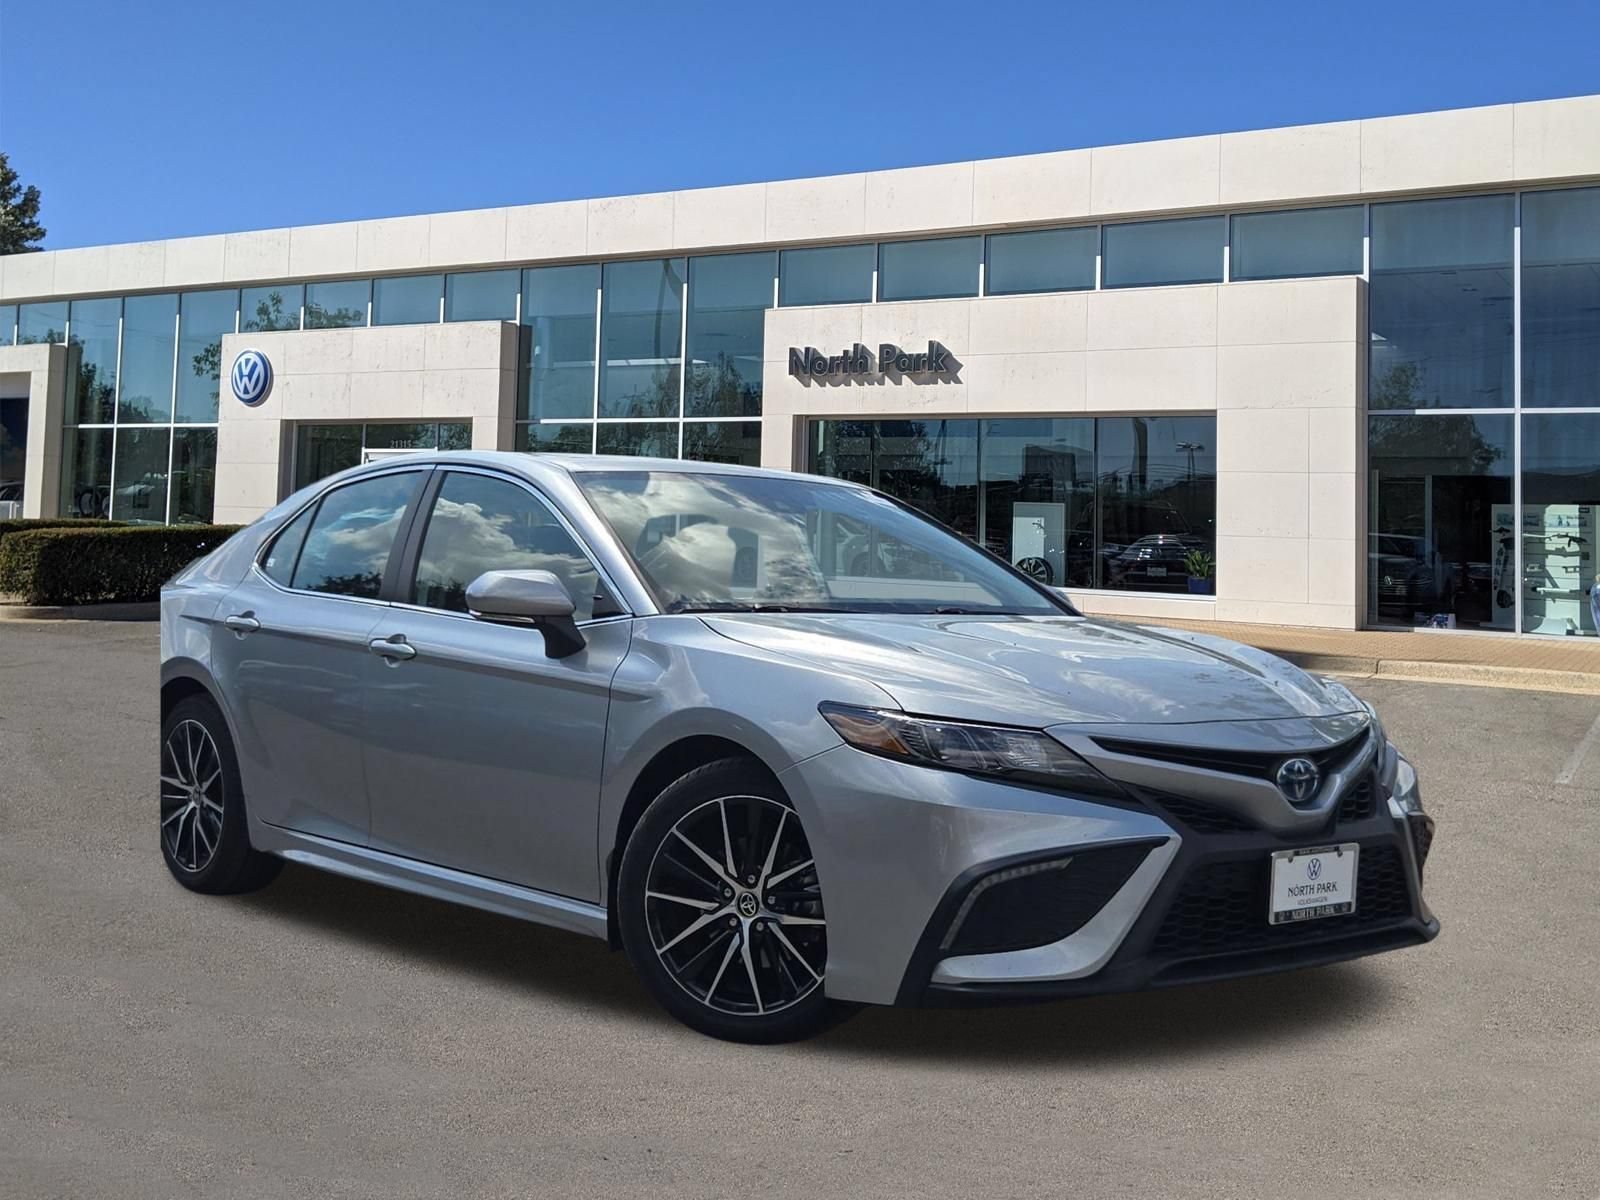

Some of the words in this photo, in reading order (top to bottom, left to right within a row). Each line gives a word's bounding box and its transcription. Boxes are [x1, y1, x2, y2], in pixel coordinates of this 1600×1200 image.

[788, 342, 871, 376] North
[878, 340, 949, 374] Park
[1288, 884, 1315, 897] NORTH
[1316, 881, 1338, 894] PARK
